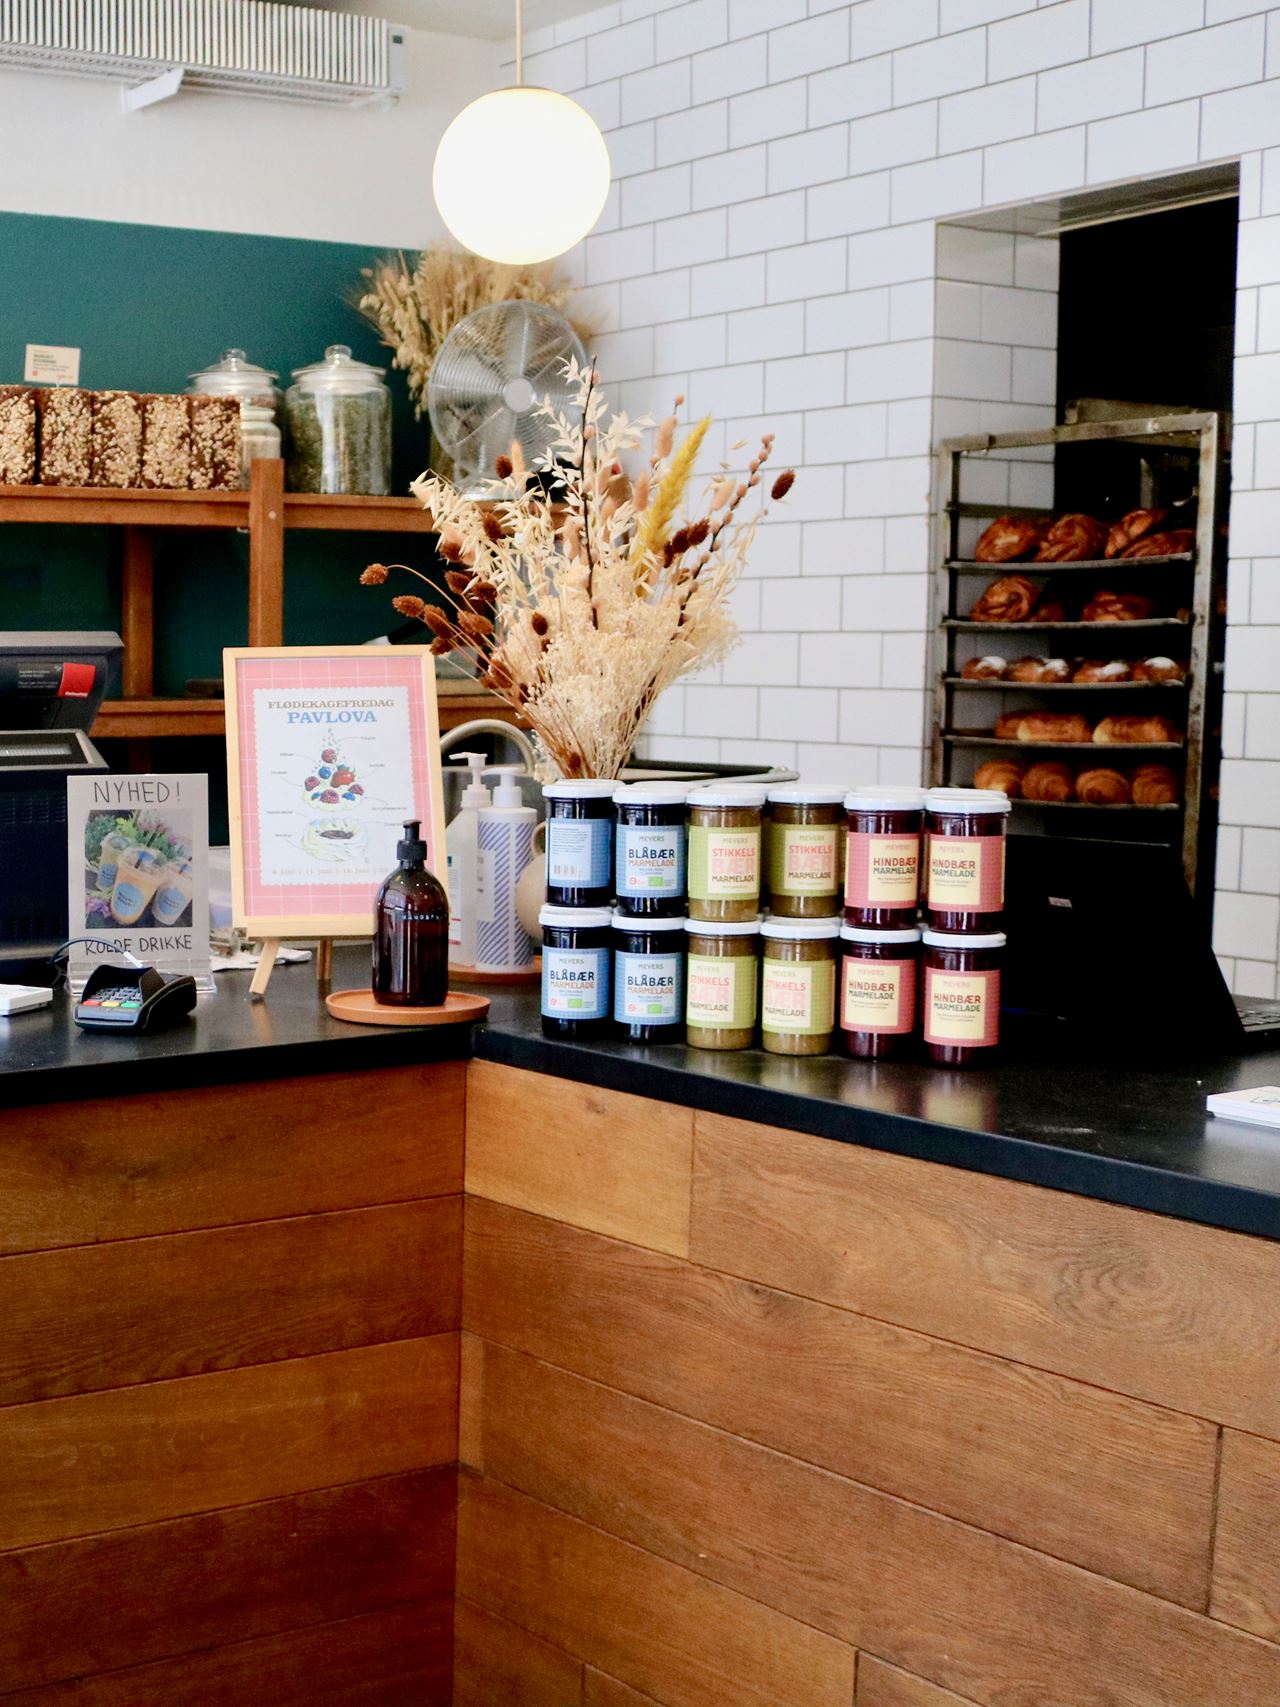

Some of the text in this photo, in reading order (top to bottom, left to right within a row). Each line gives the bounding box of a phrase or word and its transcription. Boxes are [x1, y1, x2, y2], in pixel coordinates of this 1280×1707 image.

[268, 699, 395, 709] FLØDEKAGEFREDAG
[287, 711, 377, 724] PAVLOVA
[94, 781, 181, 803] NYHED!
[628, 847, 675, 859] BLÅBÆR
[712, 848, 756, 857] STIKKELS
[788, 845, 832, 854] STIKKELS
[873, 857, 916, 867] HINDBÆR
[932, 860, 975, 869] HINDBÆR
[873, 867, 916, 875] MARMELADE
[932, 868, 975, 877] MARMELADE
[712, 875, 755, 883] MARMELADE
[139, 935, 193, 953] DRIKKE
[550, 969, 595, 981] BLÅBÆR
[627, 974, 674, 986] BLÅBÆR
[550, 981, 595, 989] MARMELADE
[627, 986, 673, 994] MARMELADE
[849, 982, 895, 991] HINDBÆR
[848, 990, 894, 1000] MARMELADE
[934, 994, 981, 1004] HINDBÆR
[934, 1002, 981, 1012] MARMELADE
